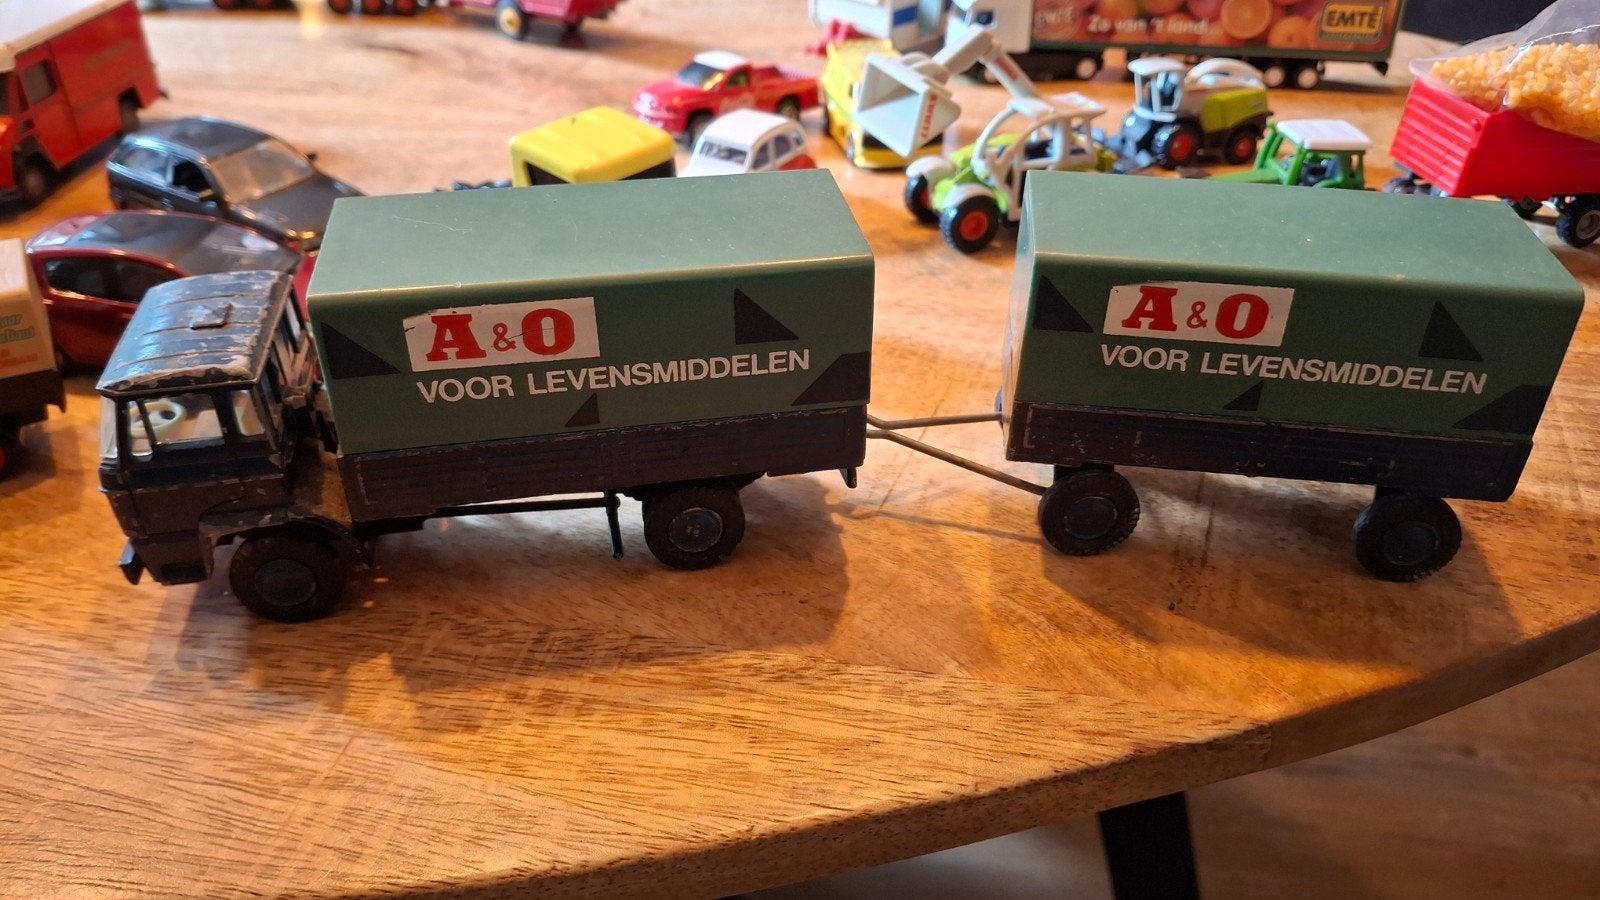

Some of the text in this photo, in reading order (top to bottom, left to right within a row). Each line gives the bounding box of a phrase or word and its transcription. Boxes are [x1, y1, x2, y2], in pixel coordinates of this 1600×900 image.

[417, 349, 810, 403] VOOR LEVENSMIDDELEN
[1101, 344, 1487, 394] VOOR LEVENSMIDDELEN
